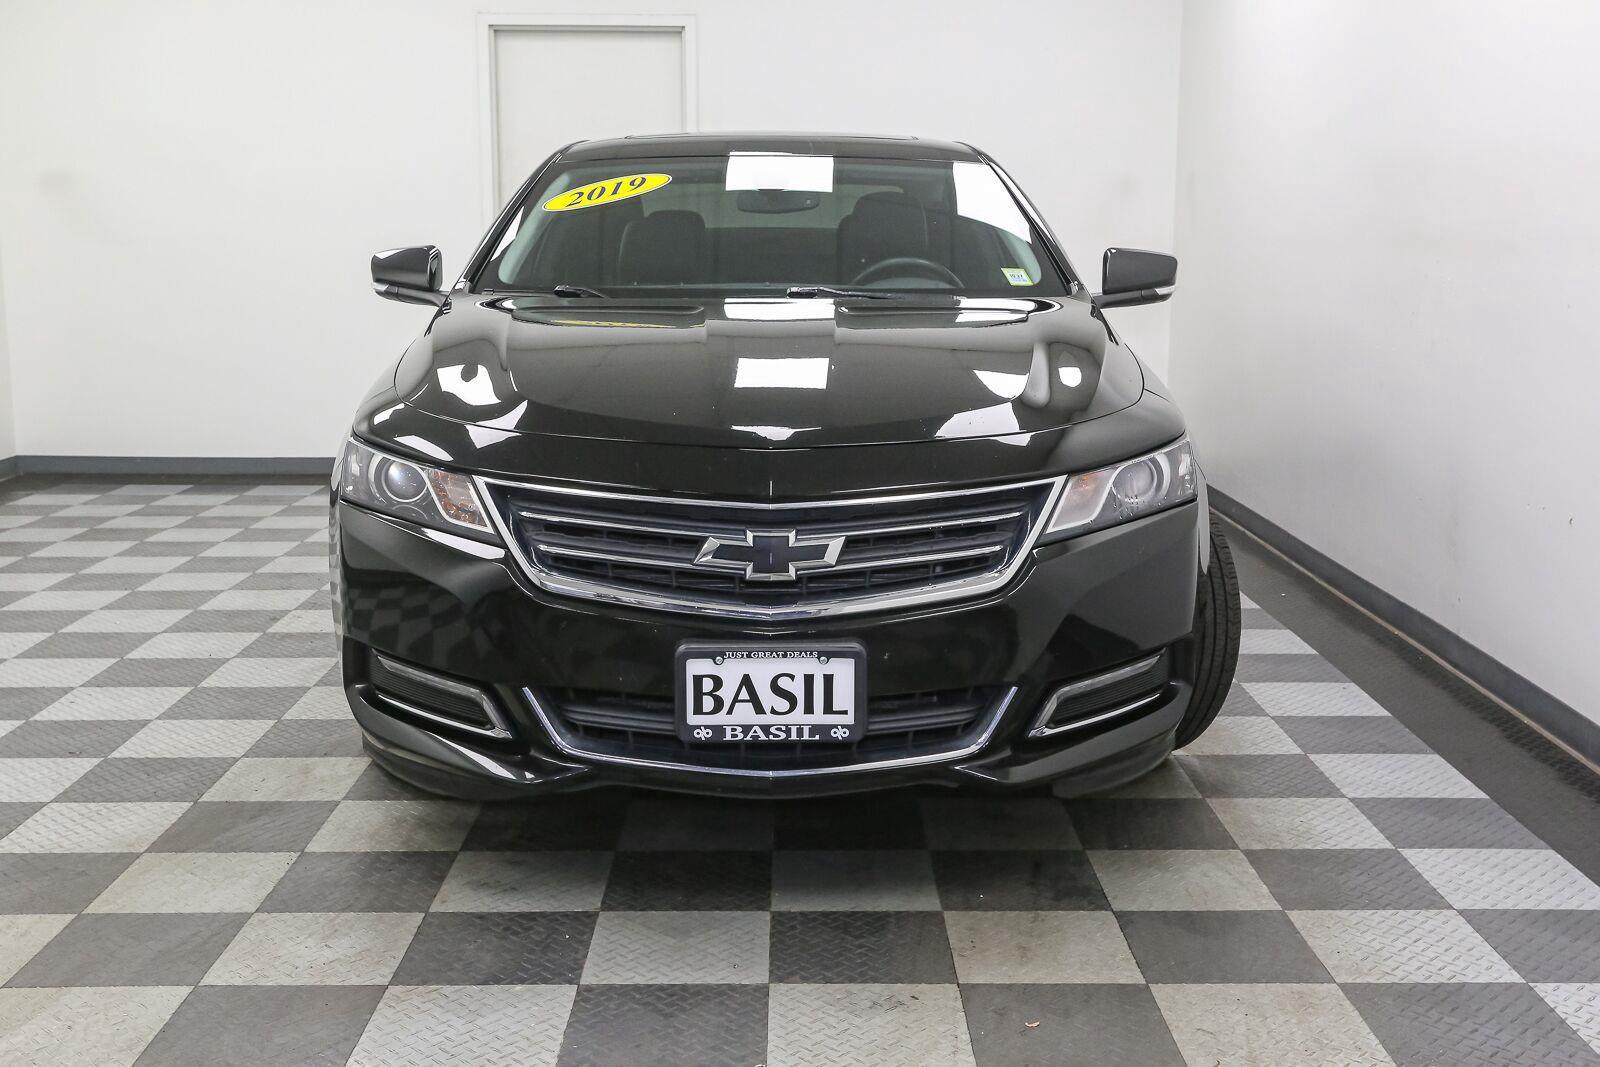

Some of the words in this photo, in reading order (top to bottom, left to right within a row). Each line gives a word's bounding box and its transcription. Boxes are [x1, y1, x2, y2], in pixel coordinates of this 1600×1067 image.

[565, 176, 647, 208] 2019
[723, 651, 749, 659] JUST
[750, 651, 785, 659] GREAT
[692, 672, 849, 716] BASIL
[722, 725, 820, 741] BASIL
